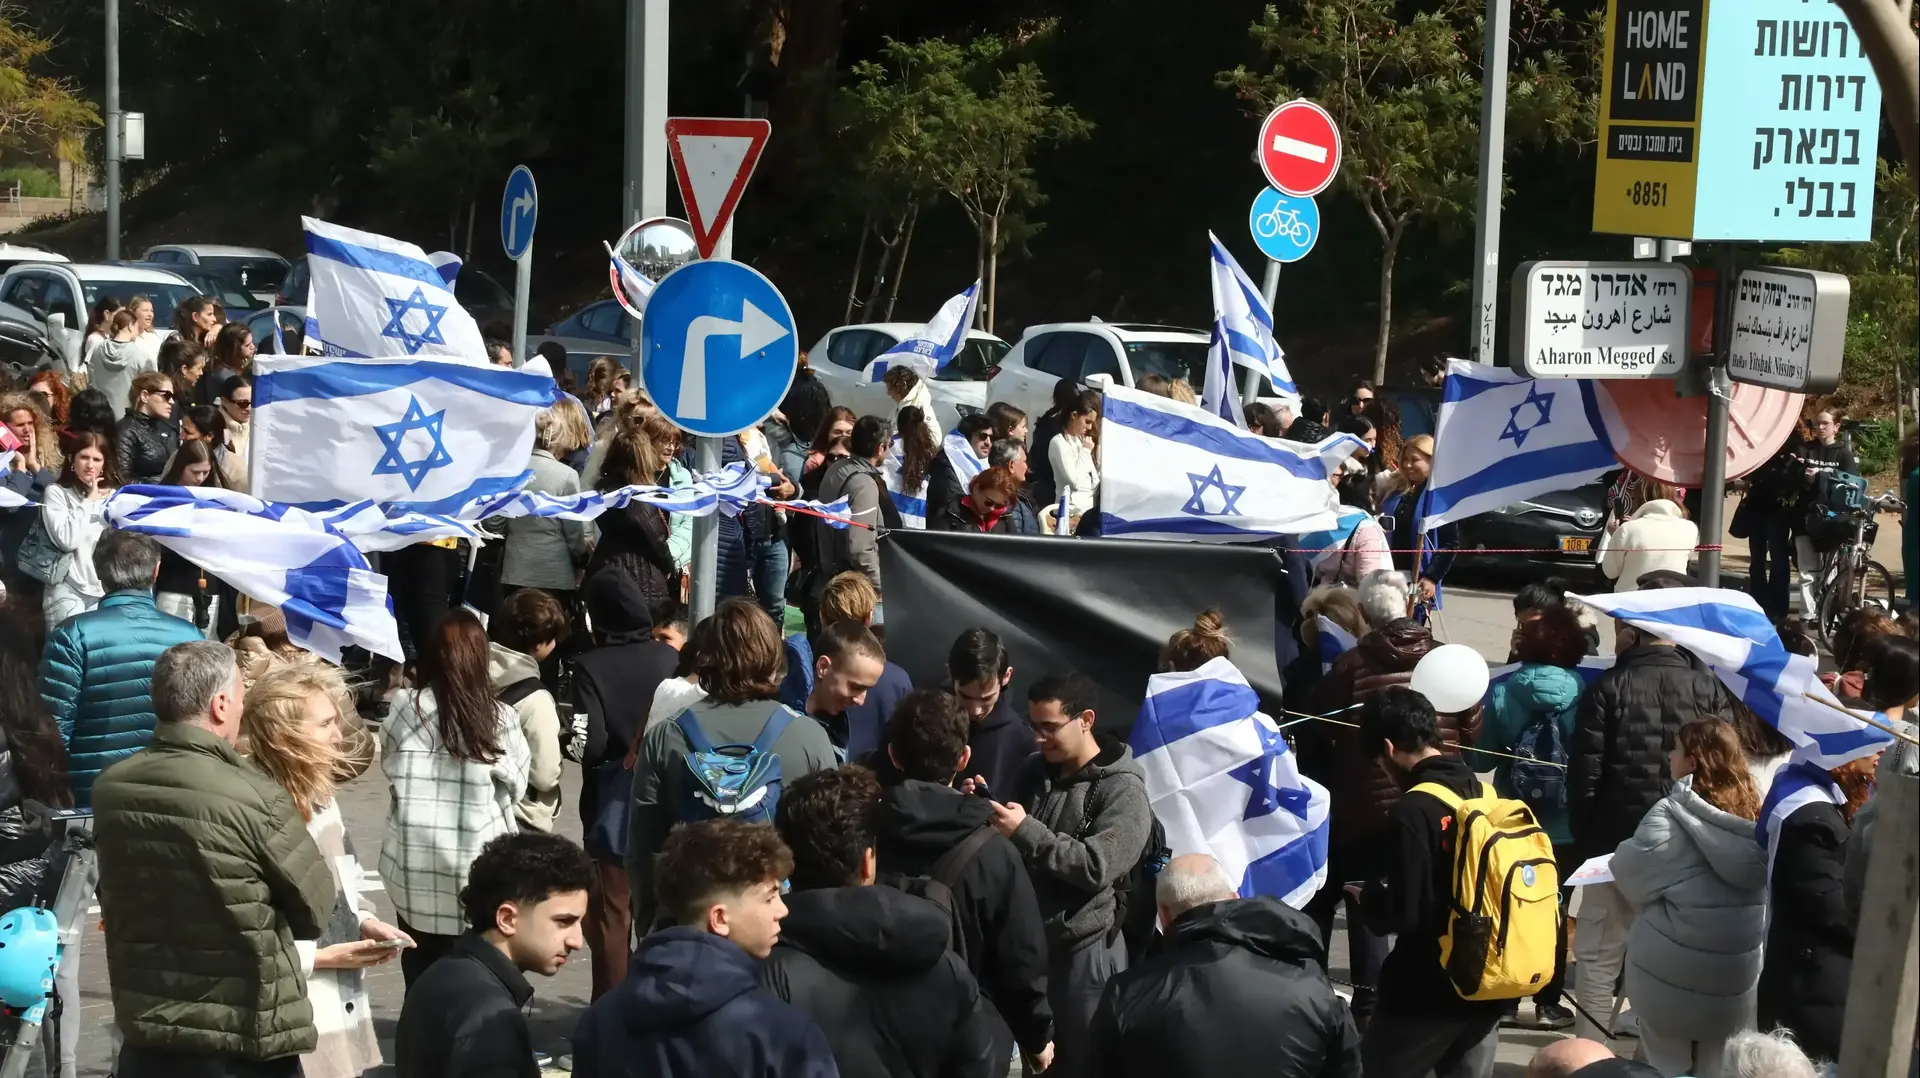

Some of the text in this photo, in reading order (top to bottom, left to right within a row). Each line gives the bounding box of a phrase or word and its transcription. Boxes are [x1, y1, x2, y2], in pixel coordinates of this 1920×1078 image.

[1627, 10, 1690, 49] HOME
[1754, 20, 1867, 58] רושות
[1624, 62, 1686, 101] LAND
[1779, 74, 1866, 112] דירות
[1668, 136, 1683, 153] בית
[1753, 128, 1860, 170] בפארק
[1541, 273, 1582, 296] מגד
[1590, 273, 1648, 302] אהרן
[1740, 278, 1761, 303] נסים
[1582, 301, 1627, 330] أهرون
[1631, 304, 1672, 334] شارع
[1790, 323, 1809, 352] شارع
[1536, 347, 1592, 365] Aharon
[1597, 346, 1656, 370] Megged
